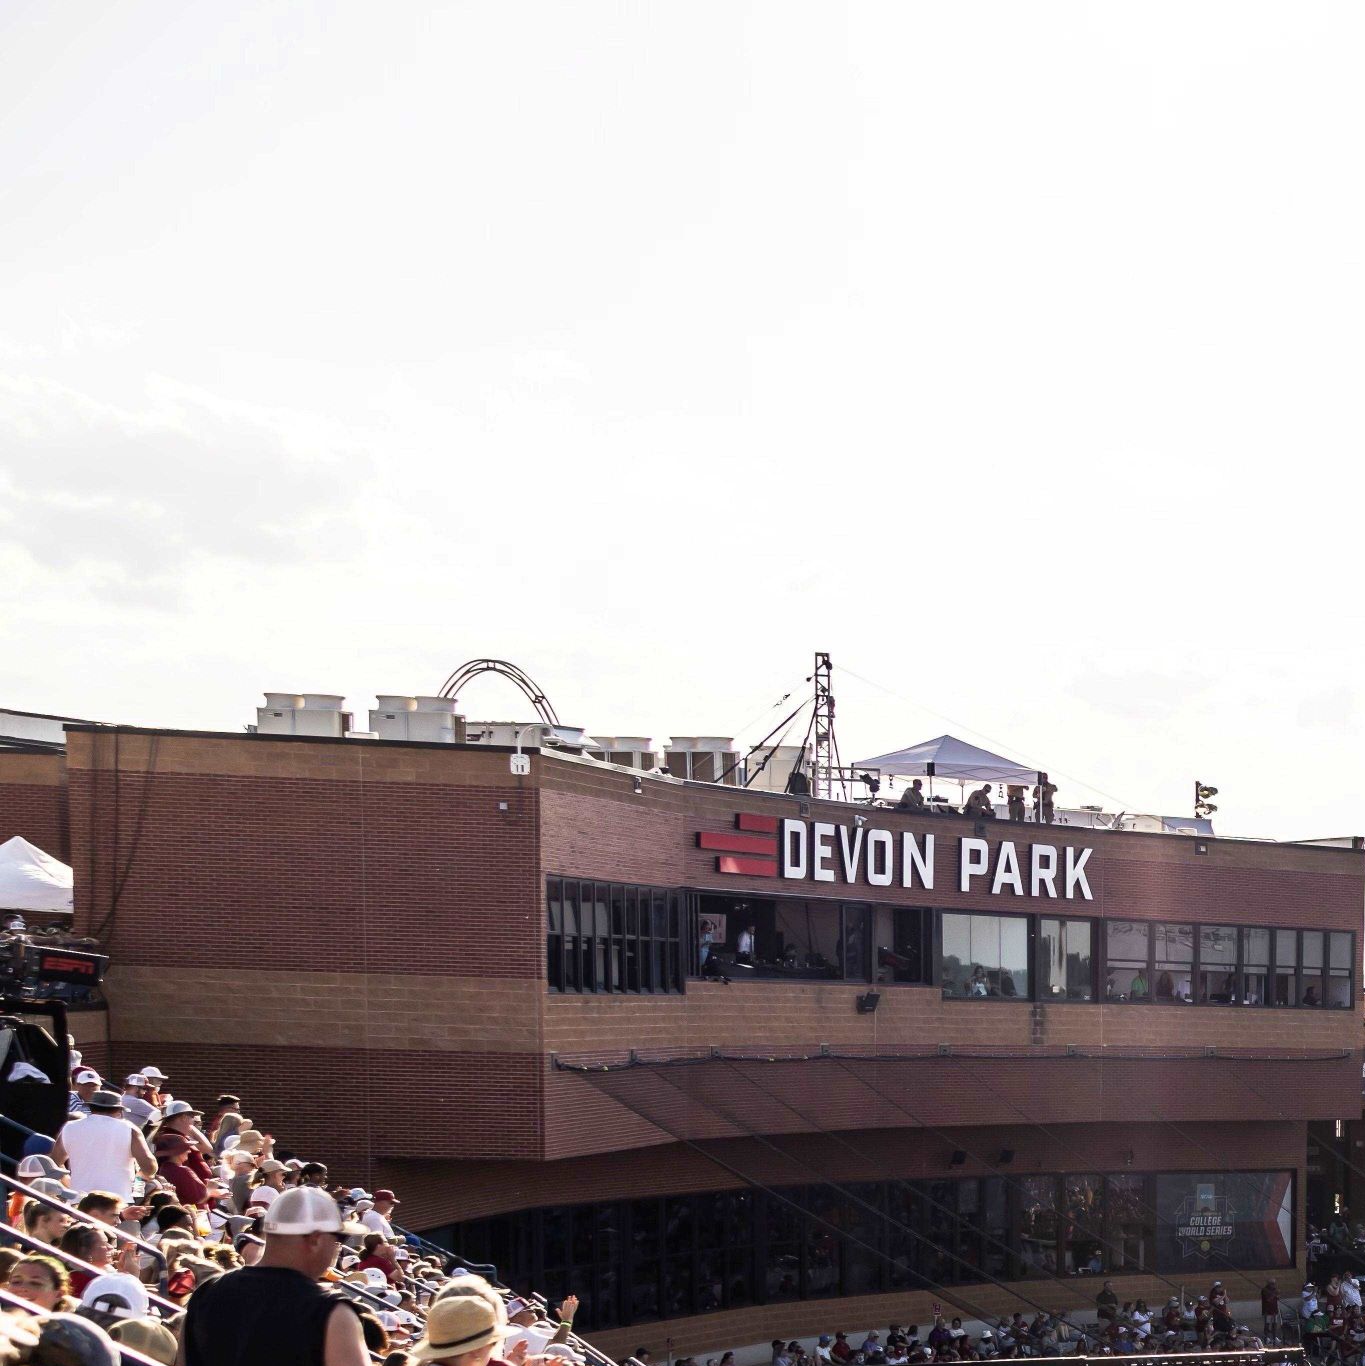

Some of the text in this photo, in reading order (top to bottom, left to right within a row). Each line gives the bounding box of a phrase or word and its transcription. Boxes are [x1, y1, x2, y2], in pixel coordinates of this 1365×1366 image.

[783, 818, 1094, 900] DEVON PARK
[1190, 1216, 1222, 1226] COLLEGE
[1179, 1226, 1232, 1236] WORLD SERIES
